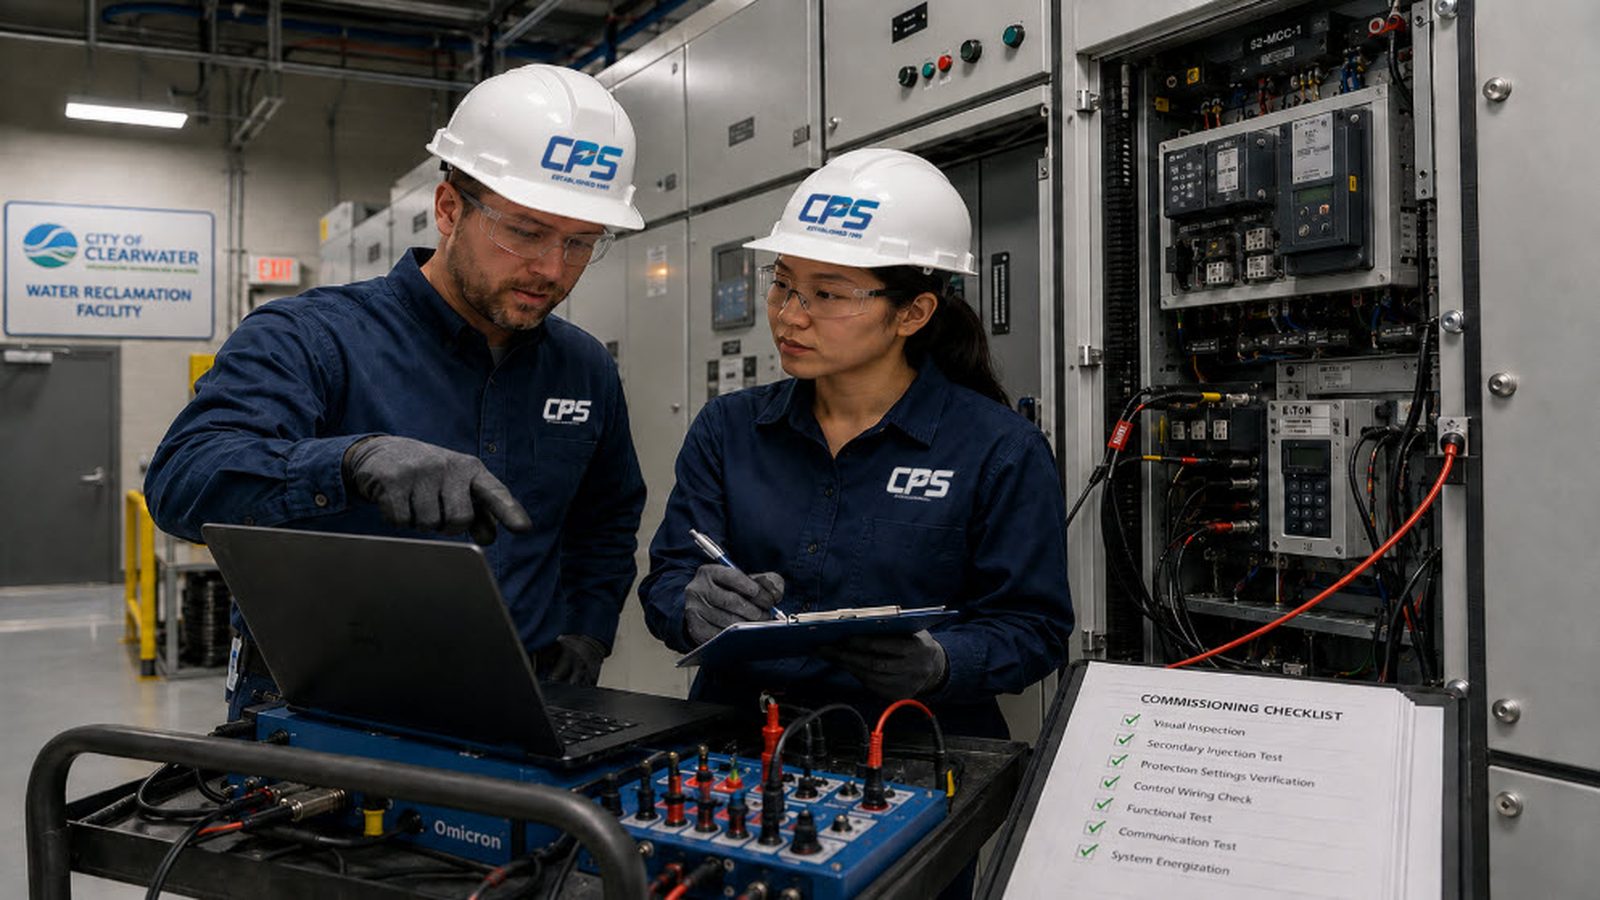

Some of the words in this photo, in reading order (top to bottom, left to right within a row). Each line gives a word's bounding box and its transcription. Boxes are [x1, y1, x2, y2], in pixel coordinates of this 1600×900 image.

[541, 135, 624, 181] CPS
[798, 193, 880, 231] CPS
[85, 233, 120, 246] CITY
[124, 234, 143, 247] OF
[84, 247, 200, 265] CLEARWATER
[258, 258, 293, 282] EXIT
[26, 284, 79, 299] WATER
[84, 286, 192, 301] RECLAMATION
[77, 304, 143, 318] FACILITY
[542, 398, 592, 422] CPS
[1282, 405, 1312, 416] ETON
[886, 466, 955, 498] CPS
[1140, 694, 1259, 714] COMMISSIONING
[1264, 705, 1344, 721] CHECKLIST
[1153, 719, 1186, 730] Visual
[1188, 722, 1246, 737] Inspection
[1147, 739, 1204, 755] Secondary
[1206, 746, 1257, 759] Injection
[1260, 752, 1283, 762] Test
[1140, 760, 1198, 775] Protection
[1200, 767, 1247, 782] Settings
[1249, 773, 1316, 788] Verification
[1133, 781, 1176, 795] Control
[1177, 787, 1215, 801] Wiring
[1217, 792, 1252, 805] Check
[1126, 804, 1187, 820] Functional
[1189, 812, 1213, 823] Test
[434, 820, 502, 850] Omicron
[1118, 827, 1210, 848] Communication
[1213, 840, 1237, 851] Test
[1111, 850, 1153, 865] System
[1156, 857, 1231, 876] Energization
